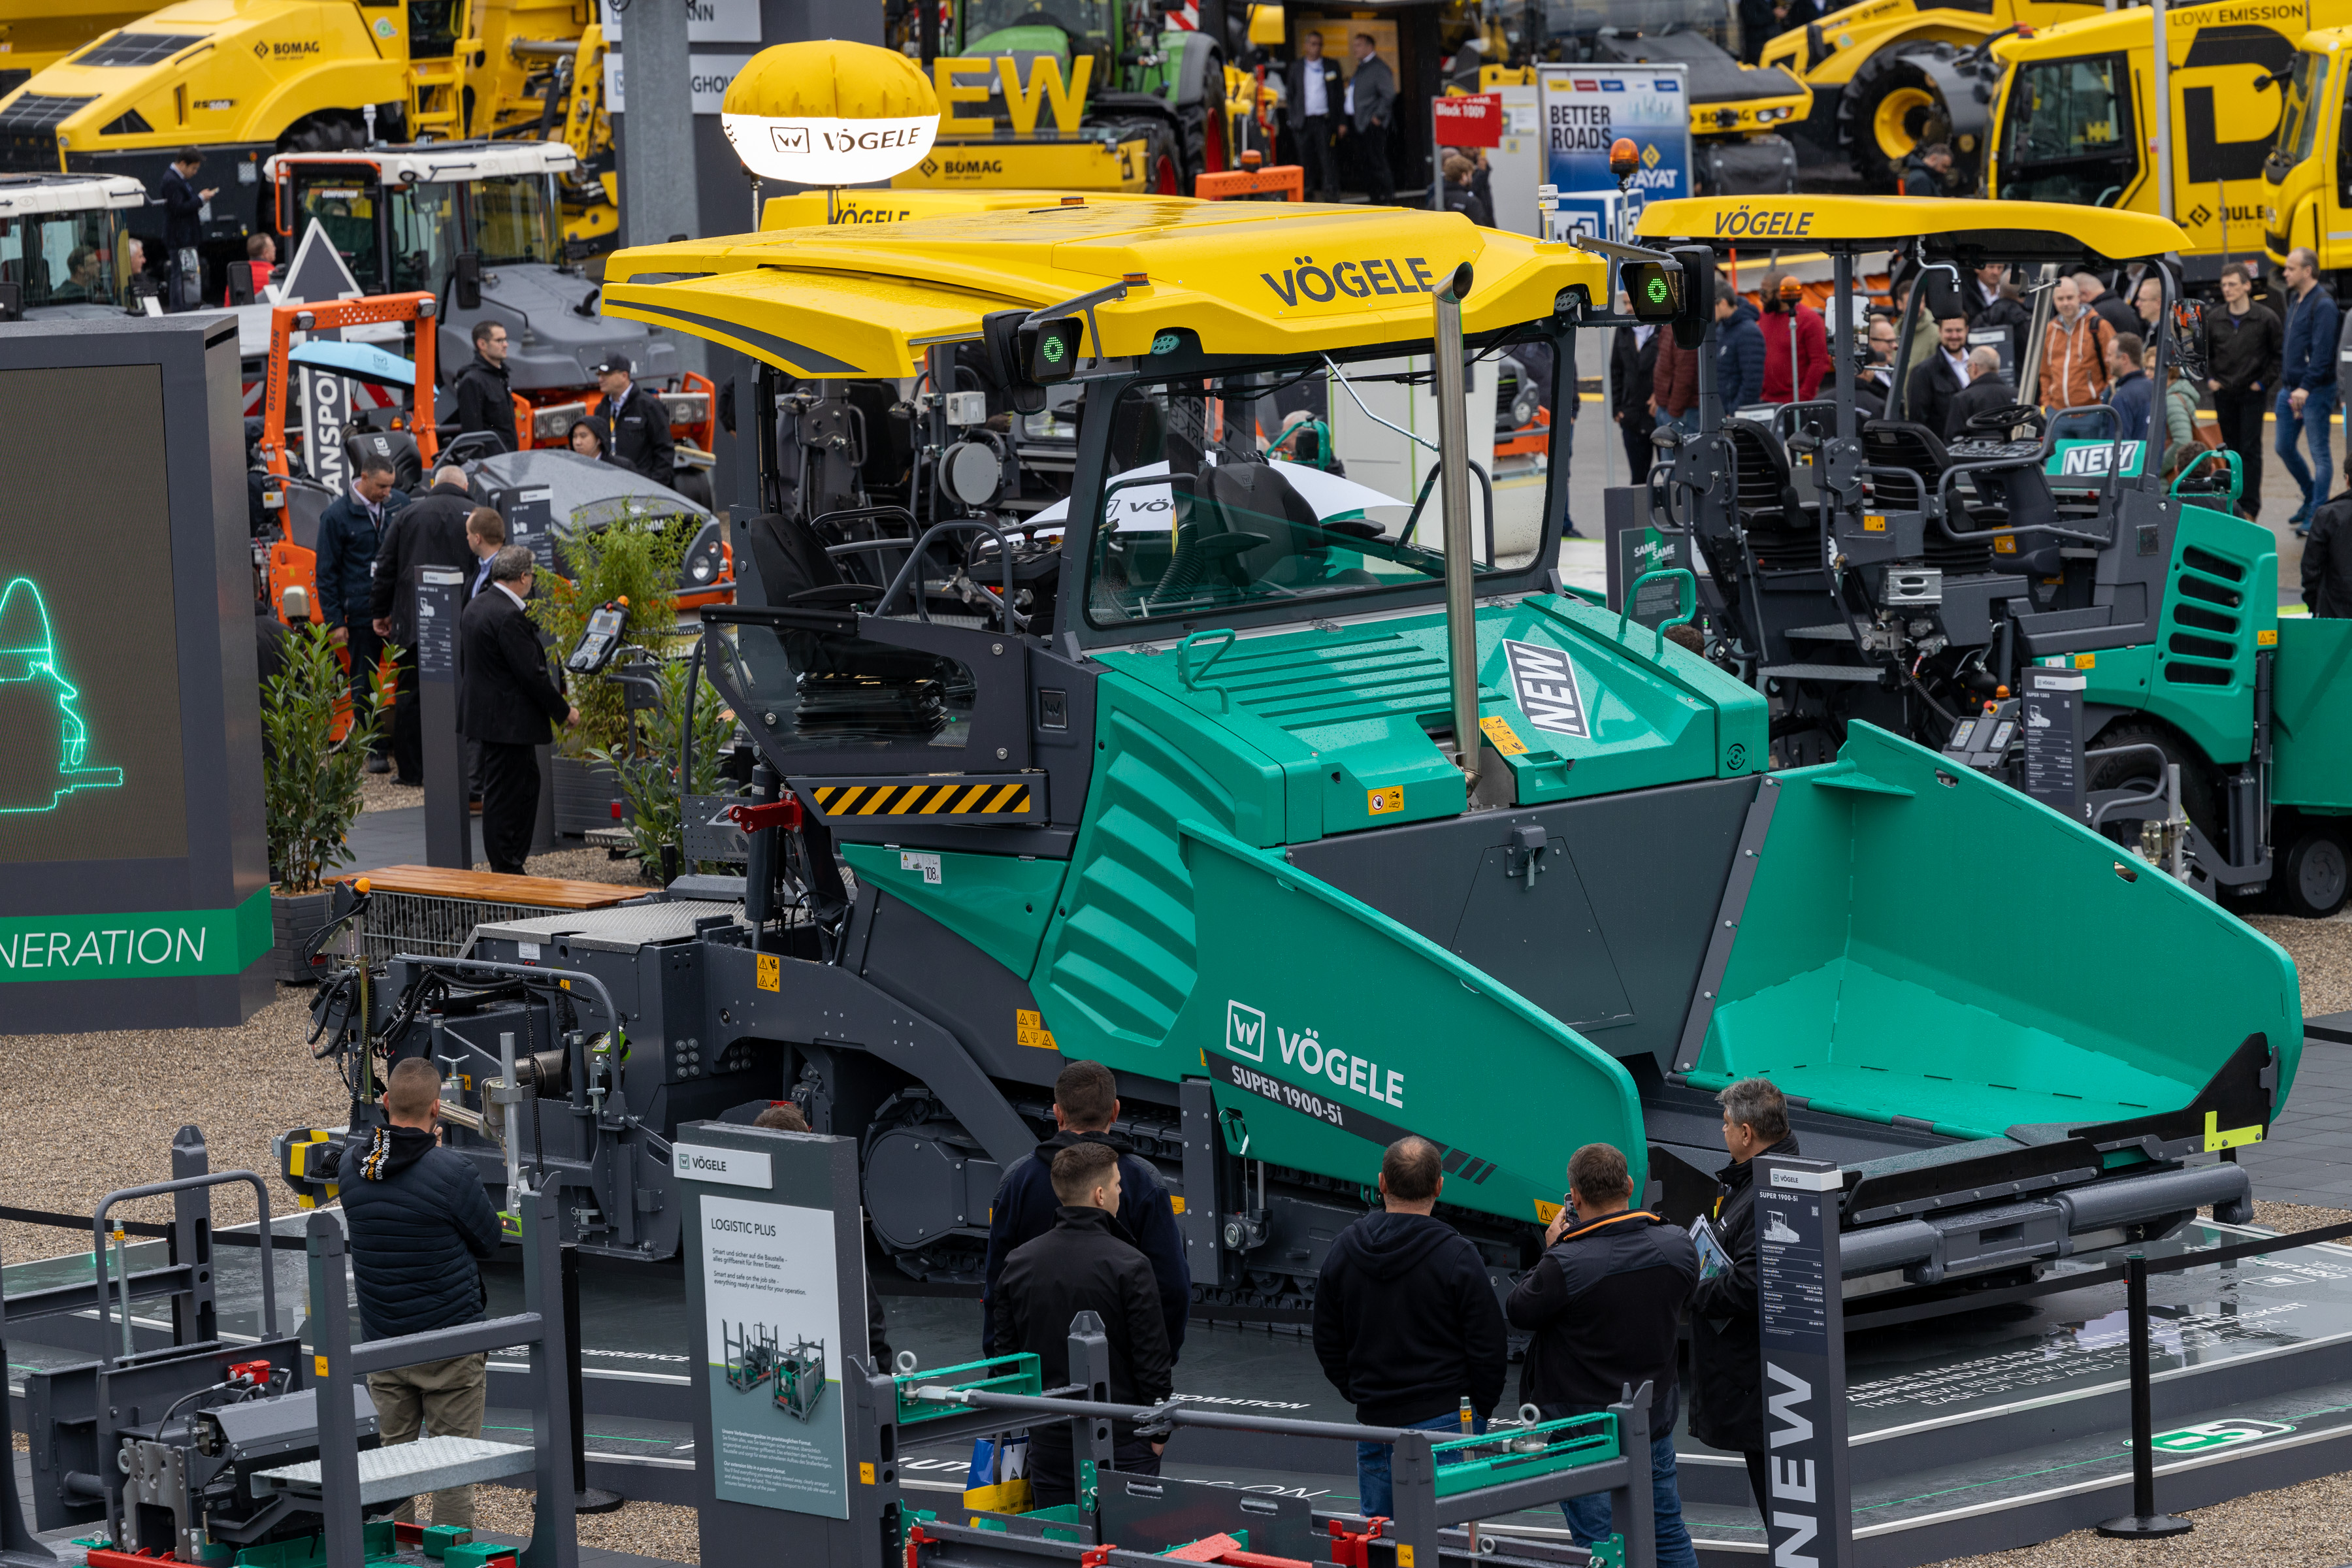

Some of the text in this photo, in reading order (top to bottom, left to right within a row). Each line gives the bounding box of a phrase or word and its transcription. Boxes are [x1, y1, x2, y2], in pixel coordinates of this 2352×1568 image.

[2174, 5, 2303, 26] LOW EMISSION
[274, 41, 319, 54] BOMAG
[934, 56, 1094, 135] EW
[1437, 103, 1461, 116] Block
[1551, 105, 1610, 125] BETTER
[1553, 128, 1612, 149] ROADS
[945, 159, 1003, 174] BOMAG
[1715, 204, 1814, 235] VÖGELE
[1260, 255, 1435, 307] VÖGELE
[269, 329, 280, 411] OSCILLATION
[2066, 444, 2134, 474] NEW
[629, 519, 664, 532] HMM
[1635, 541, 1657, 557] SAME
[1652, 544, 1675, 560] SAME
[1635, 564, 1645, 574] BUT
[1512, 645, 1580, 732] NEW
[925, 866, 936, 880] 108
[0, 927, 206, 968] NERATION
[1277, 1027, 1404, 1109] VÖGELE
[1232, 1065, 1343, 1126] SUPER 1900-5i
[692, 1156, 727, 1171] VÖGELE
[1780, 1175, 1799, 1183] VÖGELE
[1759, 1191, 1777, 1200] SUPER
[711, 1218, 776, 1237] LOGISTIC PLUS
[723, 1257, 745, 1266] griffbereit
[714, 1279, 736, 1288] everything
[581, 1348, 690, 1362] PERIENCE
[1848, 1375, 1920, 1390] NEUE
[1913, 1350, 2036, 1377] MASSSTAB
[1855, 1397, 1908, 1409] THE
[1904, 1386, 1960, 1399] NEW
[1960, 1357, 2102, 1388] BENCHMARK
[2097, 1348, 2130, 1359] FO
[1921, 1391, 1984, 1405] EASE
[1982, 1383, 2013, 1392] OF
[2016, 1374, 2065, 1385] USE
[2065, 1364, 2114, 1377] AND
[1767, 1361, 1819, 1568] NEW
